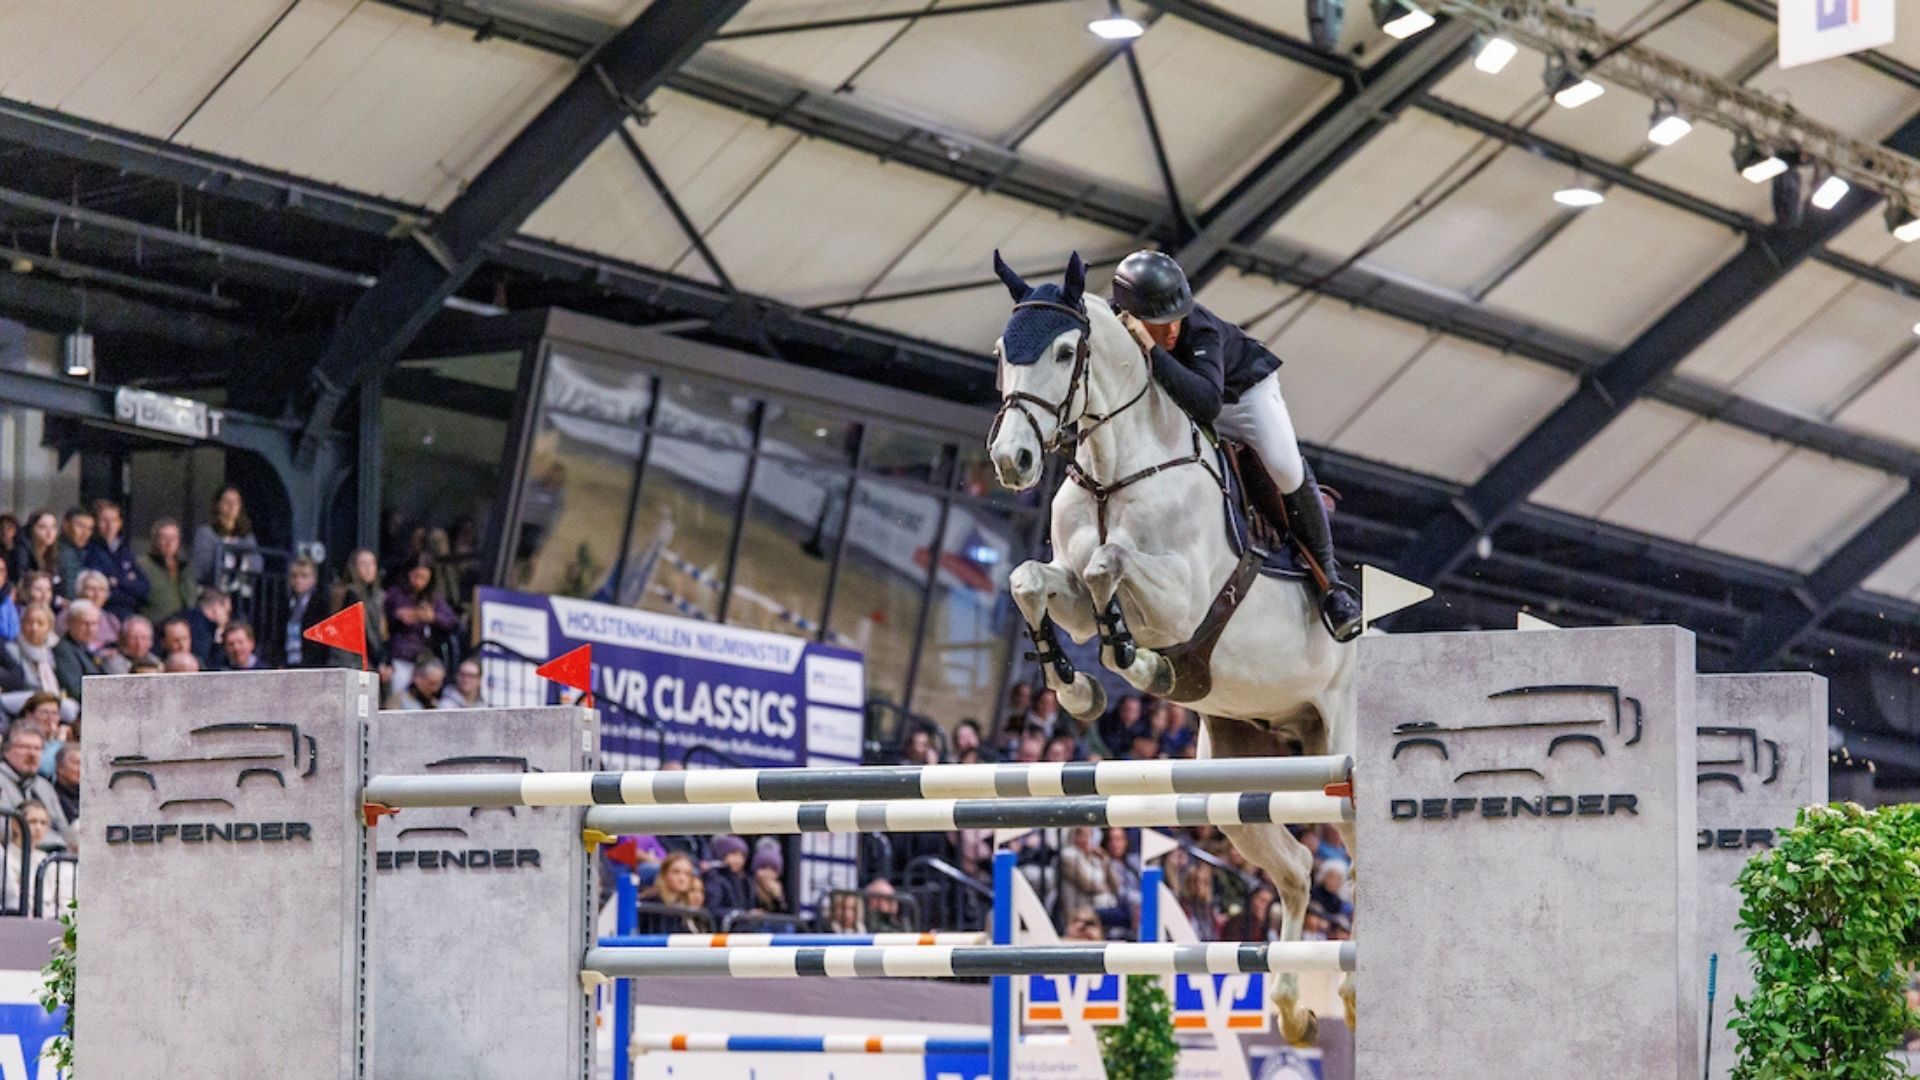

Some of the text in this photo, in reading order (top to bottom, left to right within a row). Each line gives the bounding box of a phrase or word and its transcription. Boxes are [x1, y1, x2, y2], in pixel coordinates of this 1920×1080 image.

[566, 611, 691, 647] HOLSTENHALLEN
[602, 666, 797, 740] VR CLASSICS
[1391, 794, 1639, 820] DEFENDER
[106, 822, 312, 844] DEFENDER
